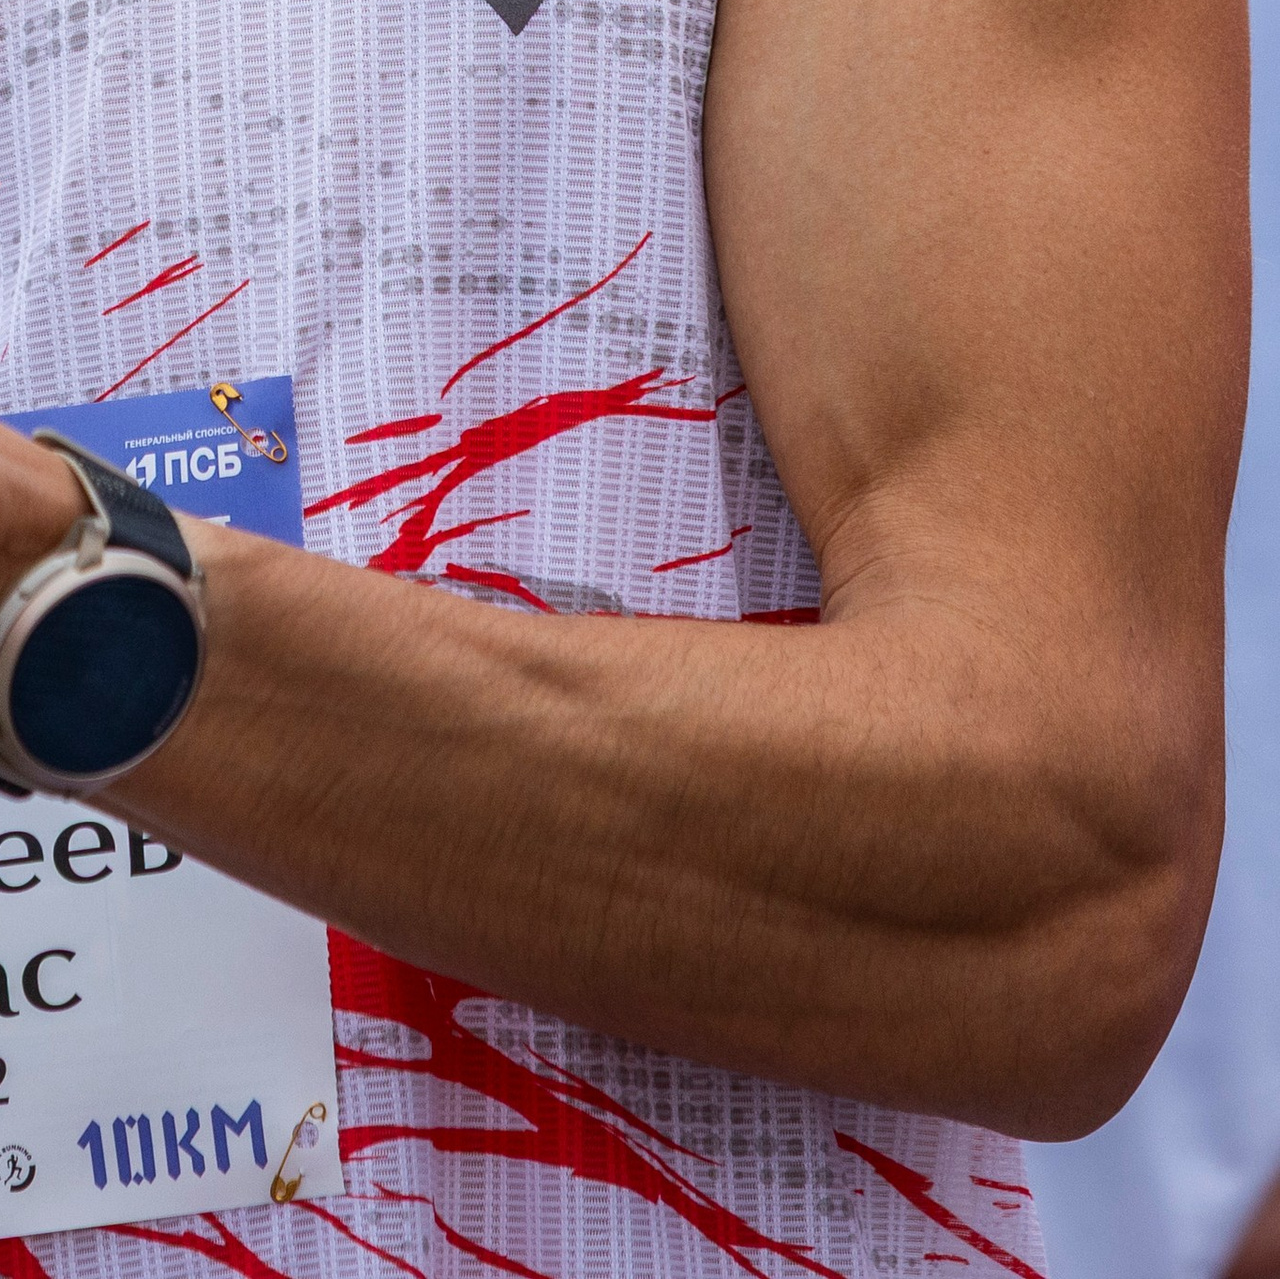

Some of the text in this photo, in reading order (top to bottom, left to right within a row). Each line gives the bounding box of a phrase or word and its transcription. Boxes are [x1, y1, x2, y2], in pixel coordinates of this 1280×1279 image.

[125, 429, 193, 449] ГЕНЕРАЛЬНЫЙ
[164, 443, 242, 486] ПСБ
[1, 1144, 32, 1161] RUNNING
